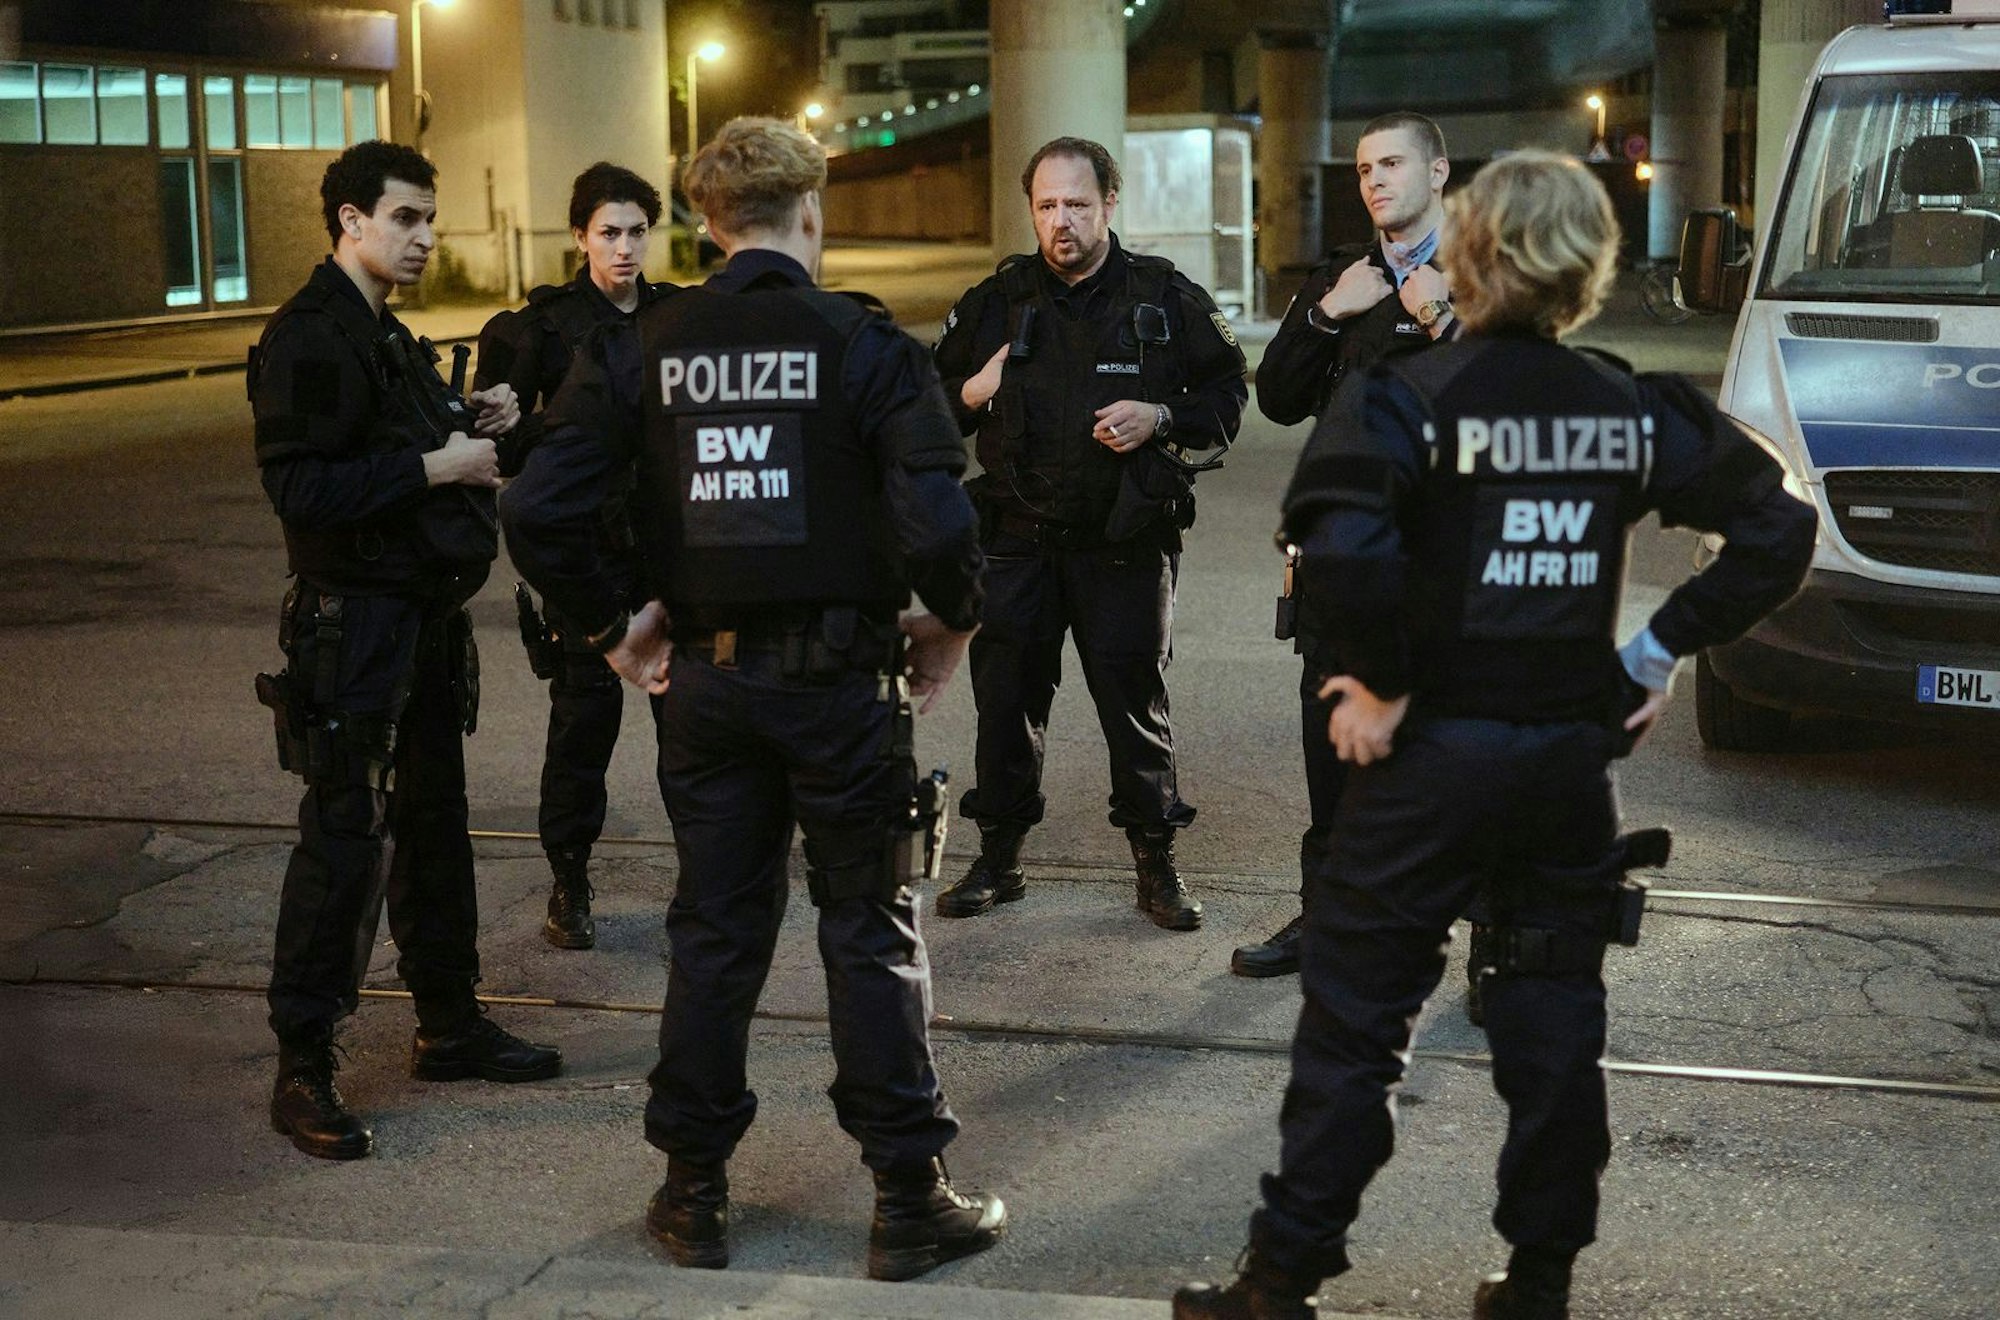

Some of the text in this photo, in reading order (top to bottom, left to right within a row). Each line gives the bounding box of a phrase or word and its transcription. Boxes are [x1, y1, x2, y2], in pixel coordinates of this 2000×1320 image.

[660, 351, 817, 405] POLIZEI
[1110, 363, 1139, 371] POLIZEI
[696, 425, 774, 464] BW
[1457, 417, 1638, 474] POLIZEI
[690, 469, 789, 501] AH FR 111
[1502, 499, 1594, 543] BW
[1481, 550, 1599, 586] AH FR 111
[1923, 686, 1931, 696] D
[1937, 671, 1992, 702] BWL
